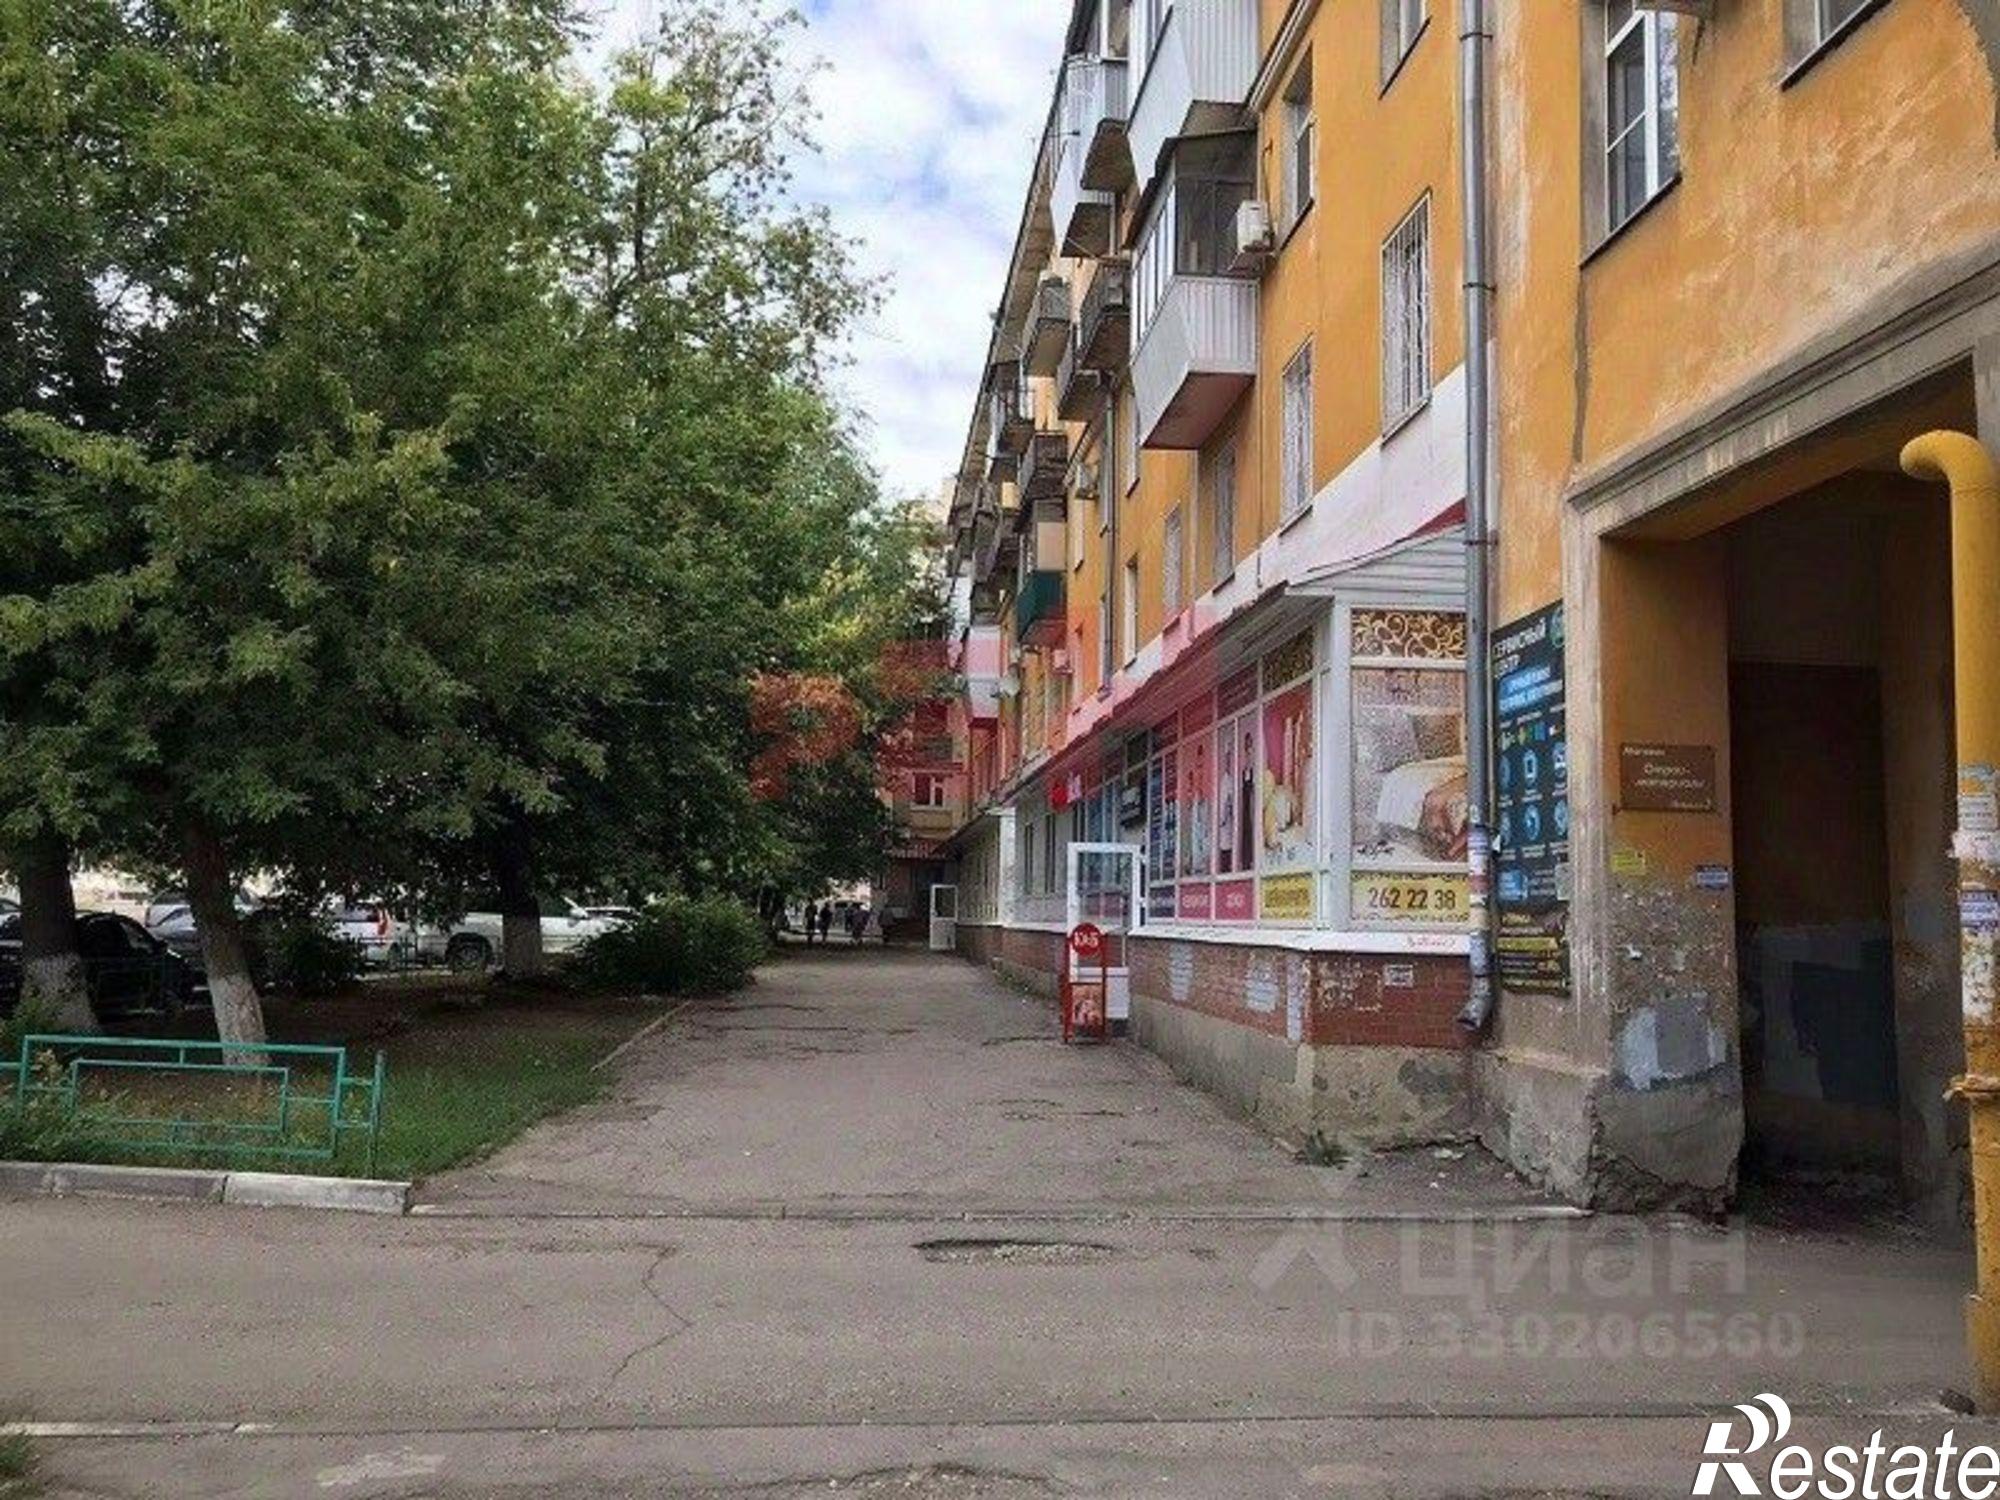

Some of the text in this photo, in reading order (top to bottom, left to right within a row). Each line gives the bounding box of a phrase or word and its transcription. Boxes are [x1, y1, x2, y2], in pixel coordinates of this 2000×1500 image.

[1368, 887, 1456, 910] 262 22 38
